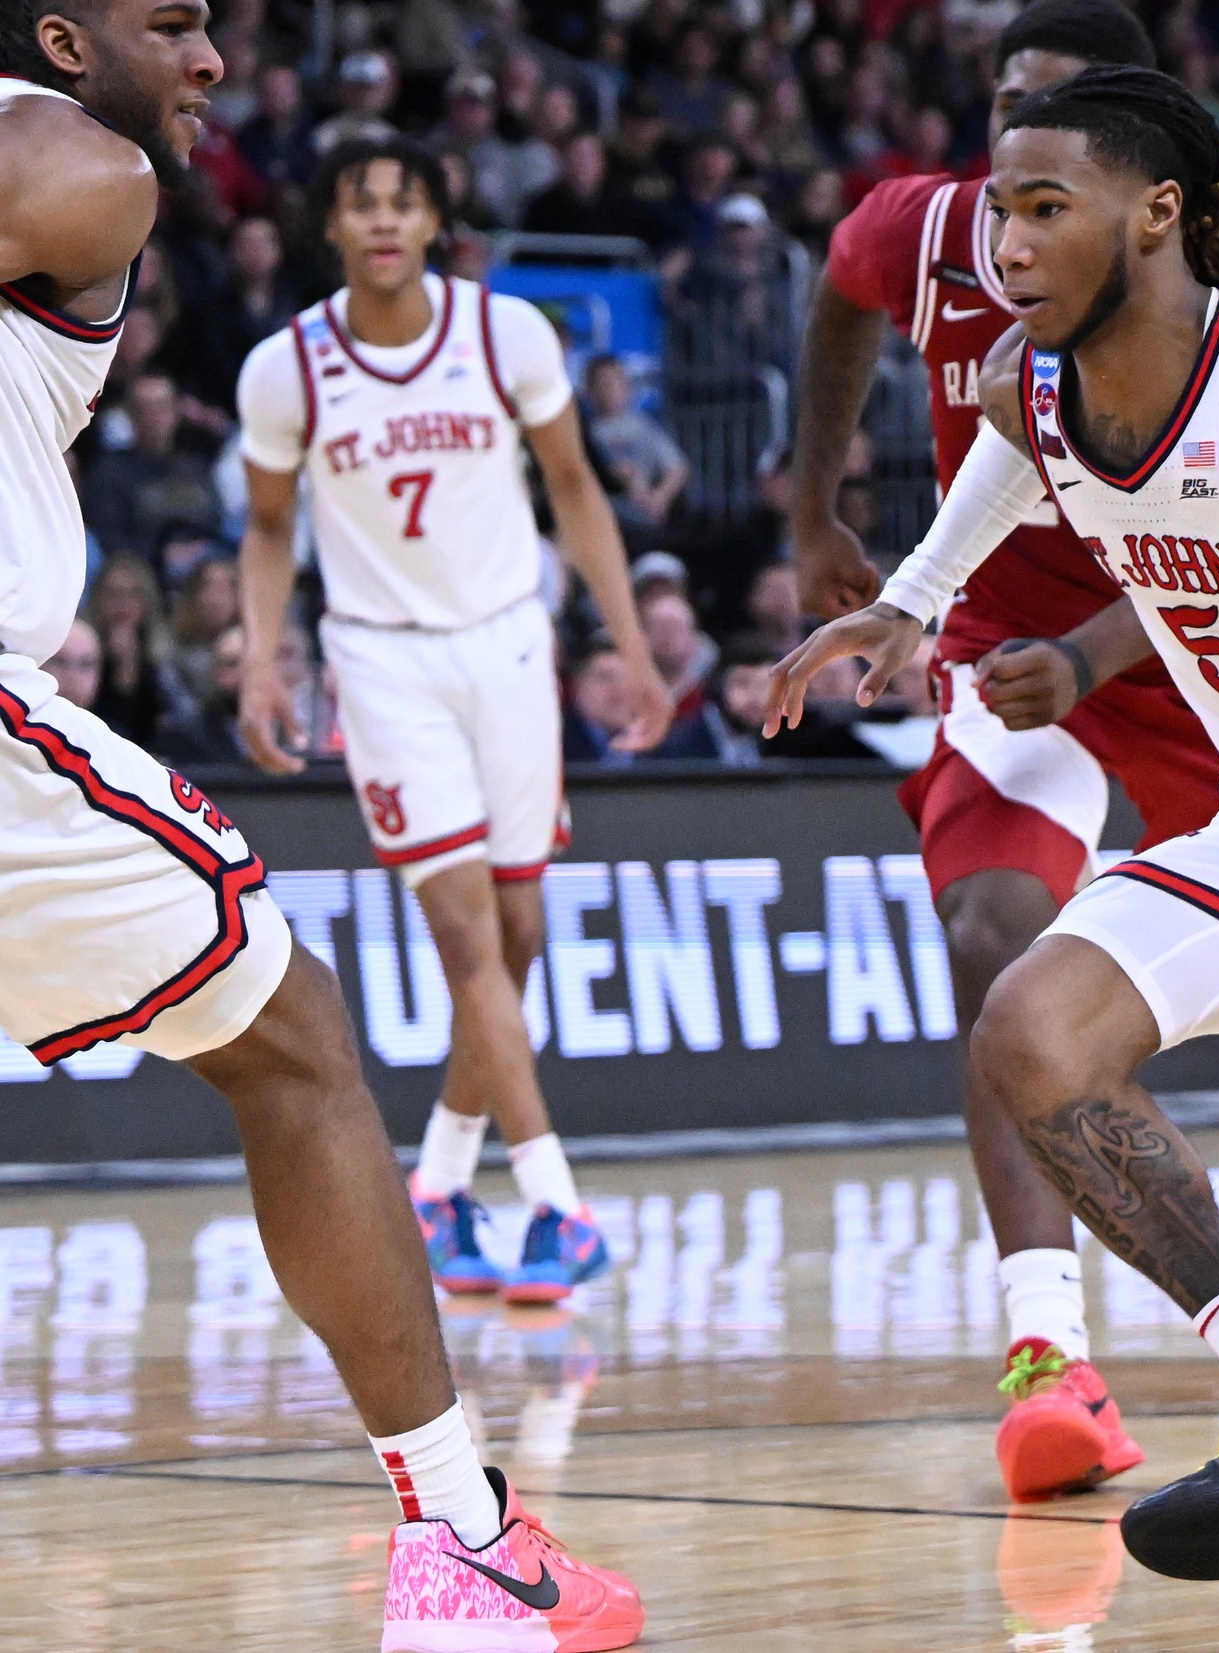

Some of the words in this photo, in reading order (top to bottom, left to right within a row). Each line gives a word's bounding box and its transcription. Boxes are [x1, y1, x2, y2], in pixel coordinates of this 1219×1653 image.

[1034, 355, 1059, 368] NCAA
[942, 358, 980, 408] RA
[1180, 487, 1218, 497] EAST
[1182, 478, 1208, 488] BIG
[389, 470, 434, 538] 7
[1080, 536, 1131, 588] T.
